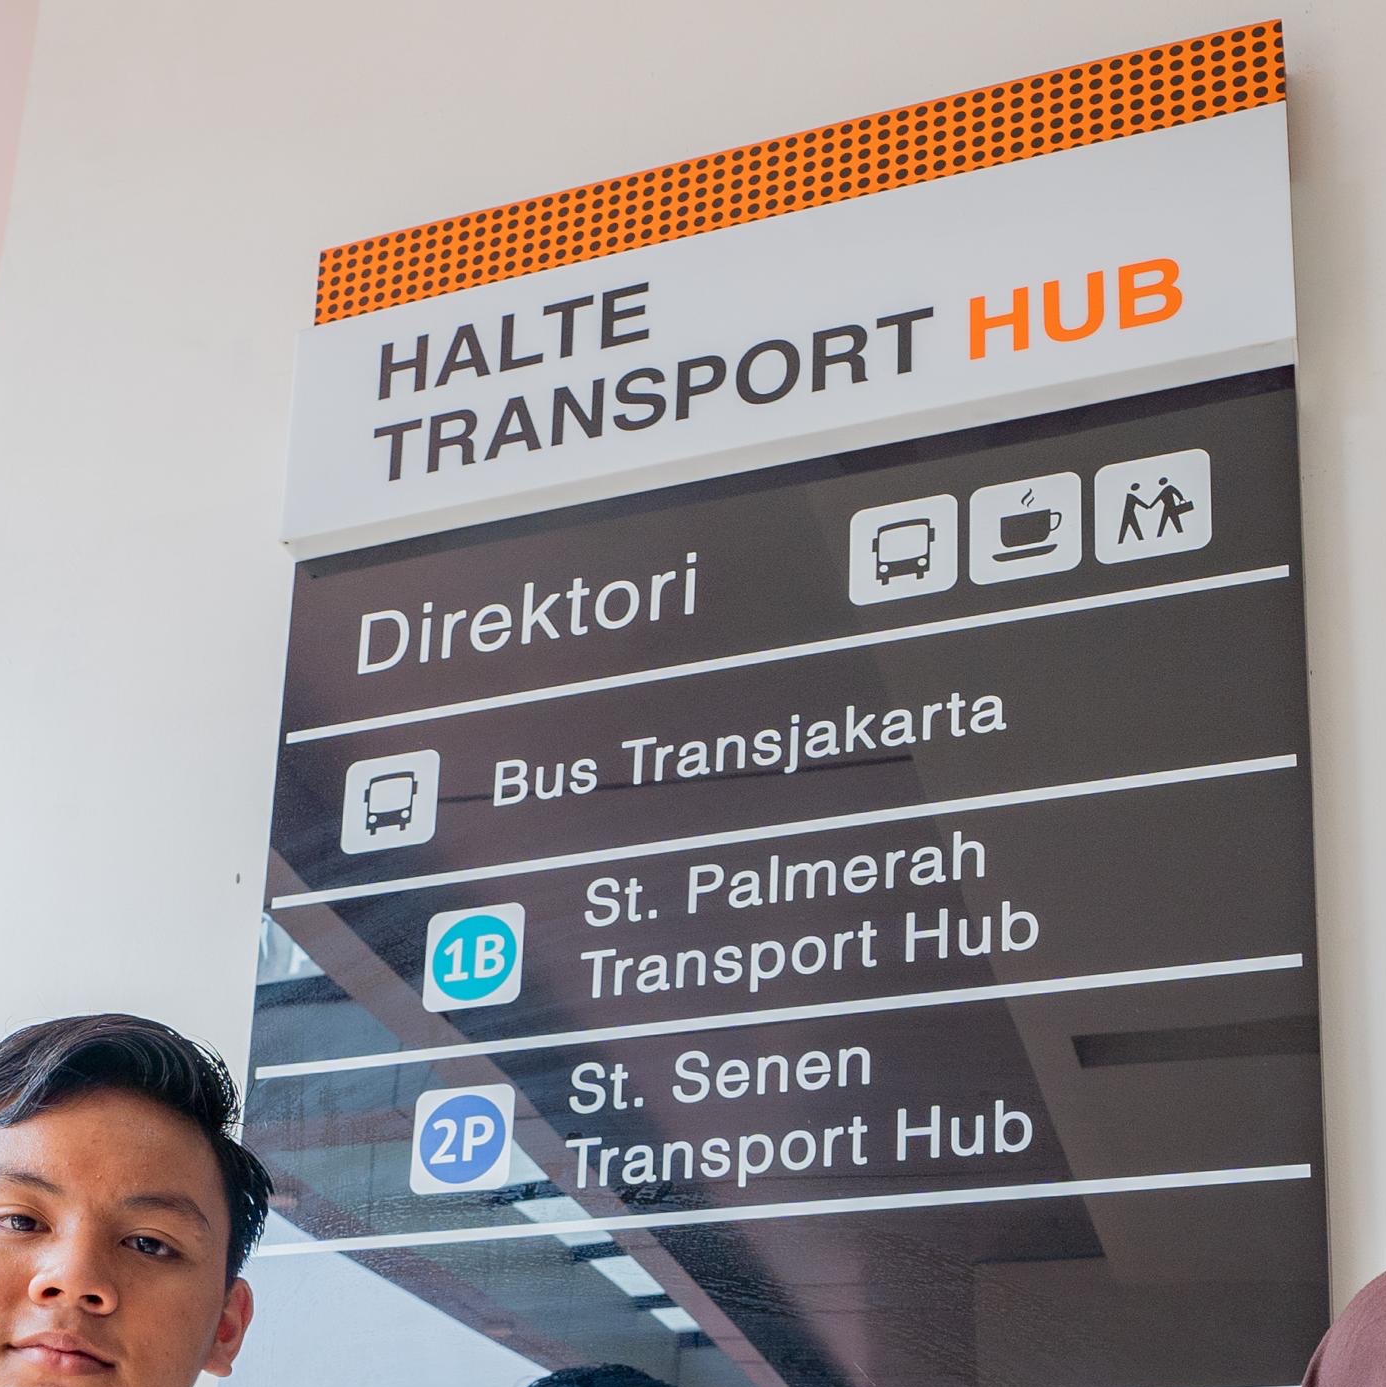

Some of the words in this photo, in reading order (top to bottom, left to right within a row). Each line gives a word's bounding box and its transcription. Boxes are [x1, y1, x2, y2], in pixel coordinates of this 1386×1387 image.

[374, 307, 933, 481] TRANSPORT
[970, 258, 1183, 360] HUB
[379, 282, 649, 400] HALTE
[358, 552, 696, 674] Direktori
[494, 759, 597, 806] Bus
[622, 693, 1006, 784] Transjakarta
[585, 878, 657, 926] St.
[688, 831, 984, 913] Palmerah
[442, 933, 506, 983] 1B
[581, 921, 877, 998] Transport
[906, 901, 1038, 962] Hub
[570, 1063, 643, 1113] St.
[673, 1047, 870, 1103] Senen
[431, 1114, 496, 1164] 2P
[566, 1117, 867, 1188] Transport
[897, 1100, 1032, 1160] Hub
